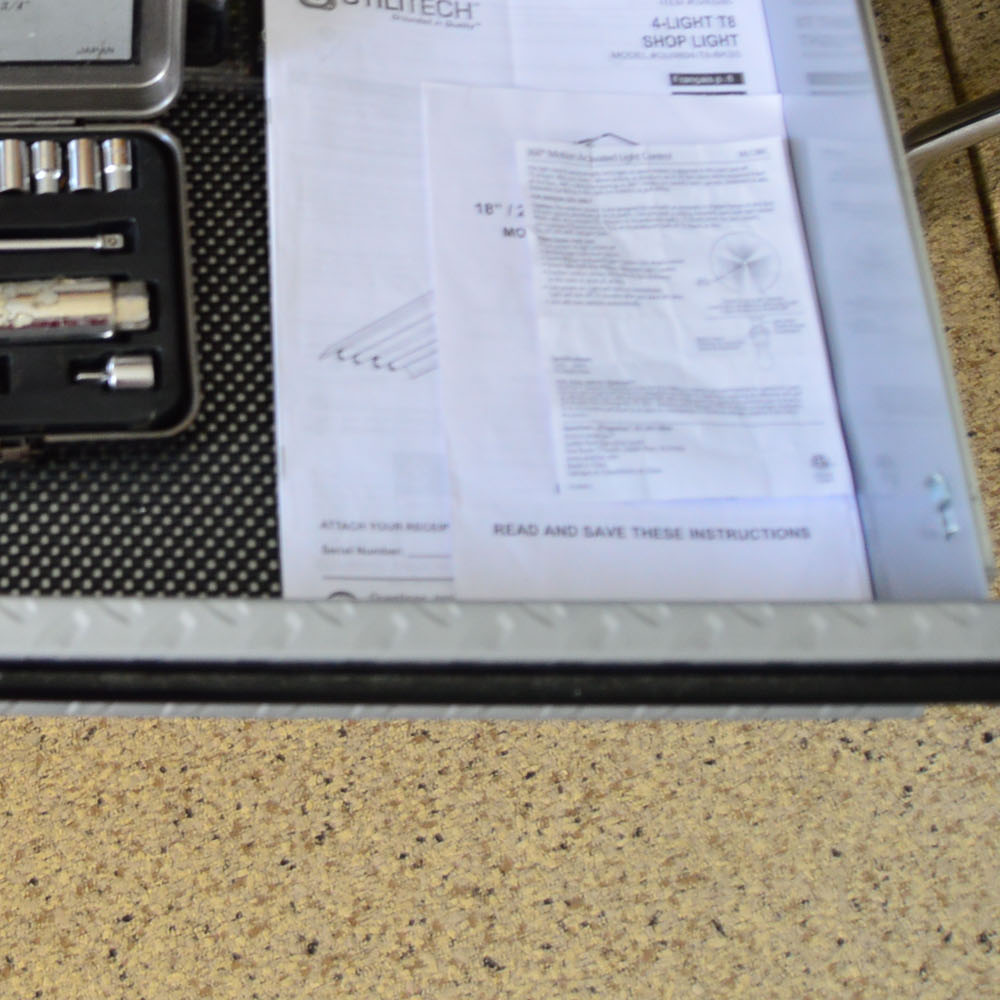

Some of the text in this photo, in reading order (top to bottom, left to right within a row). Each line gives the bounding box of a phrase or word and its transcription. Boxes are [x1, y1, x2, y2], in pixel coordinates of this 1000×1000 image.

[652, 15, 711, 30] 4-LIGHT
[642, 33, 739, 49] SHOP LIGHT
[503, 226, 527, 239] MO
[493, 524, 812, 540] READ AND SAVE THESE INSTRUCTIONS
